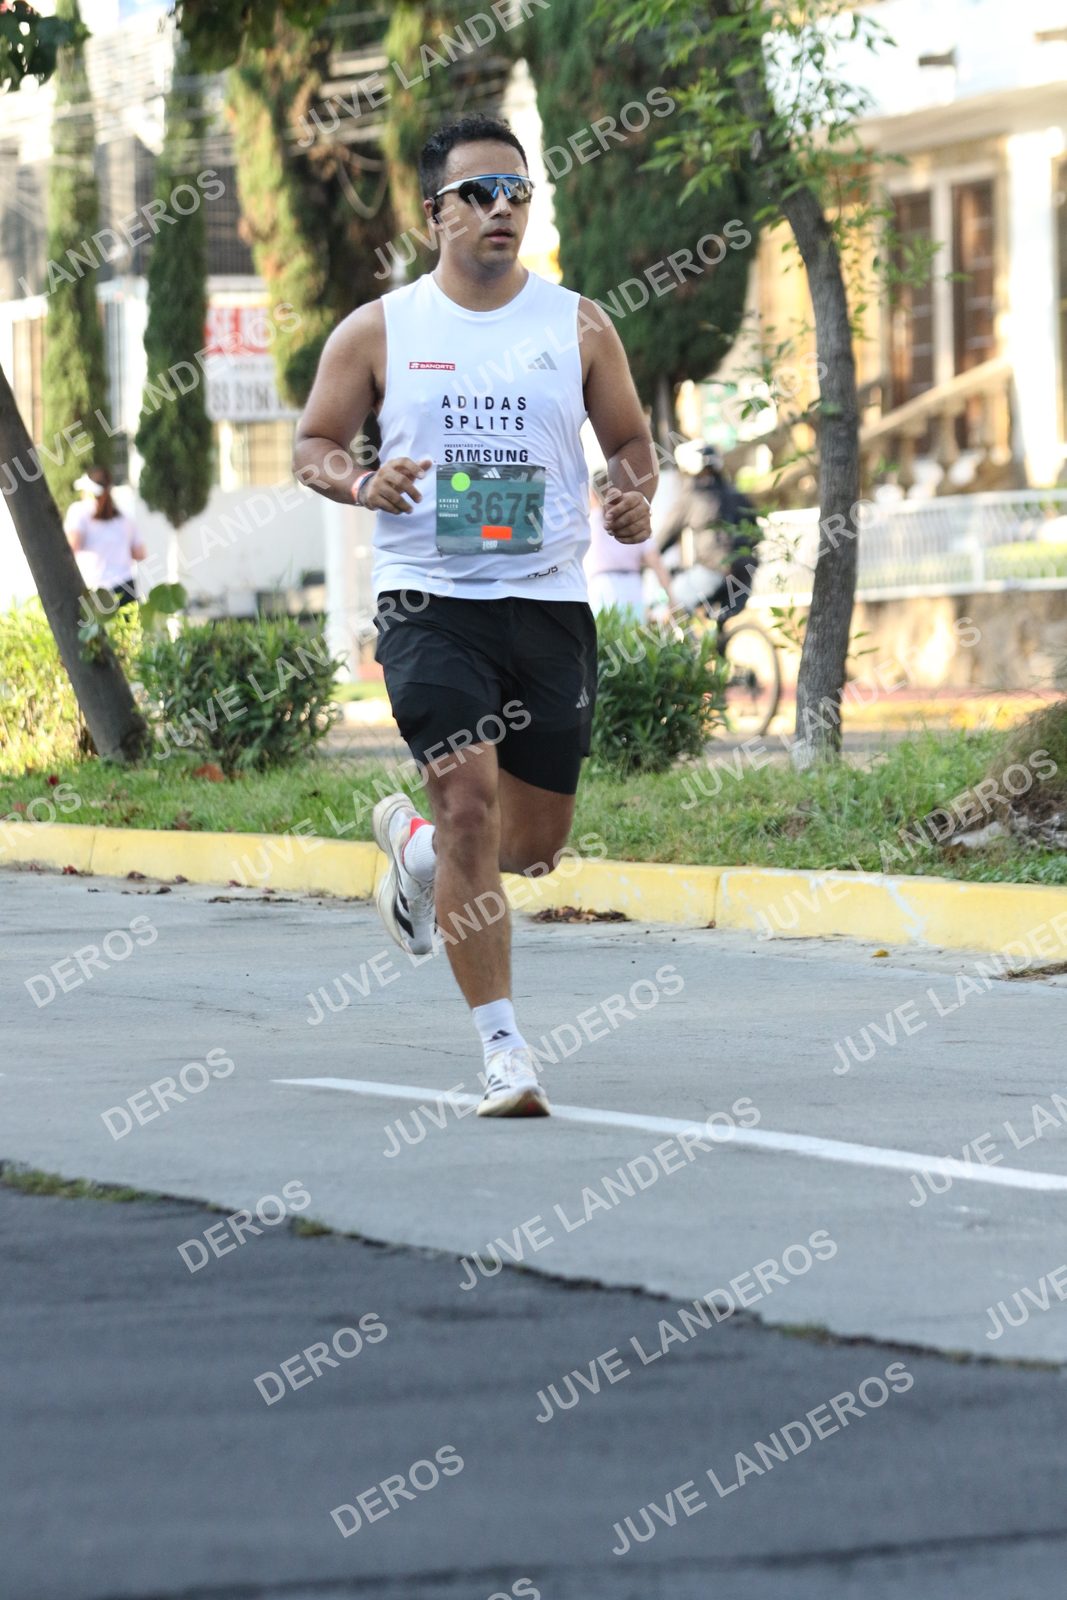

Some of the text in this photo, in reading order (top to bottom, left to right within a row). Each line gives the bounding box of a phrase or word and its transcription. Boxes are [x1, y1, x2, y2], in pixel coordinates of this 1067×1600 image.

[441, 395, 527, 411] ADIDAS
[444, 415, 525, 431] SPLITS
[444, 449, 529, 463] SAMSUNG
[464, 491, 541, 525] 3675
